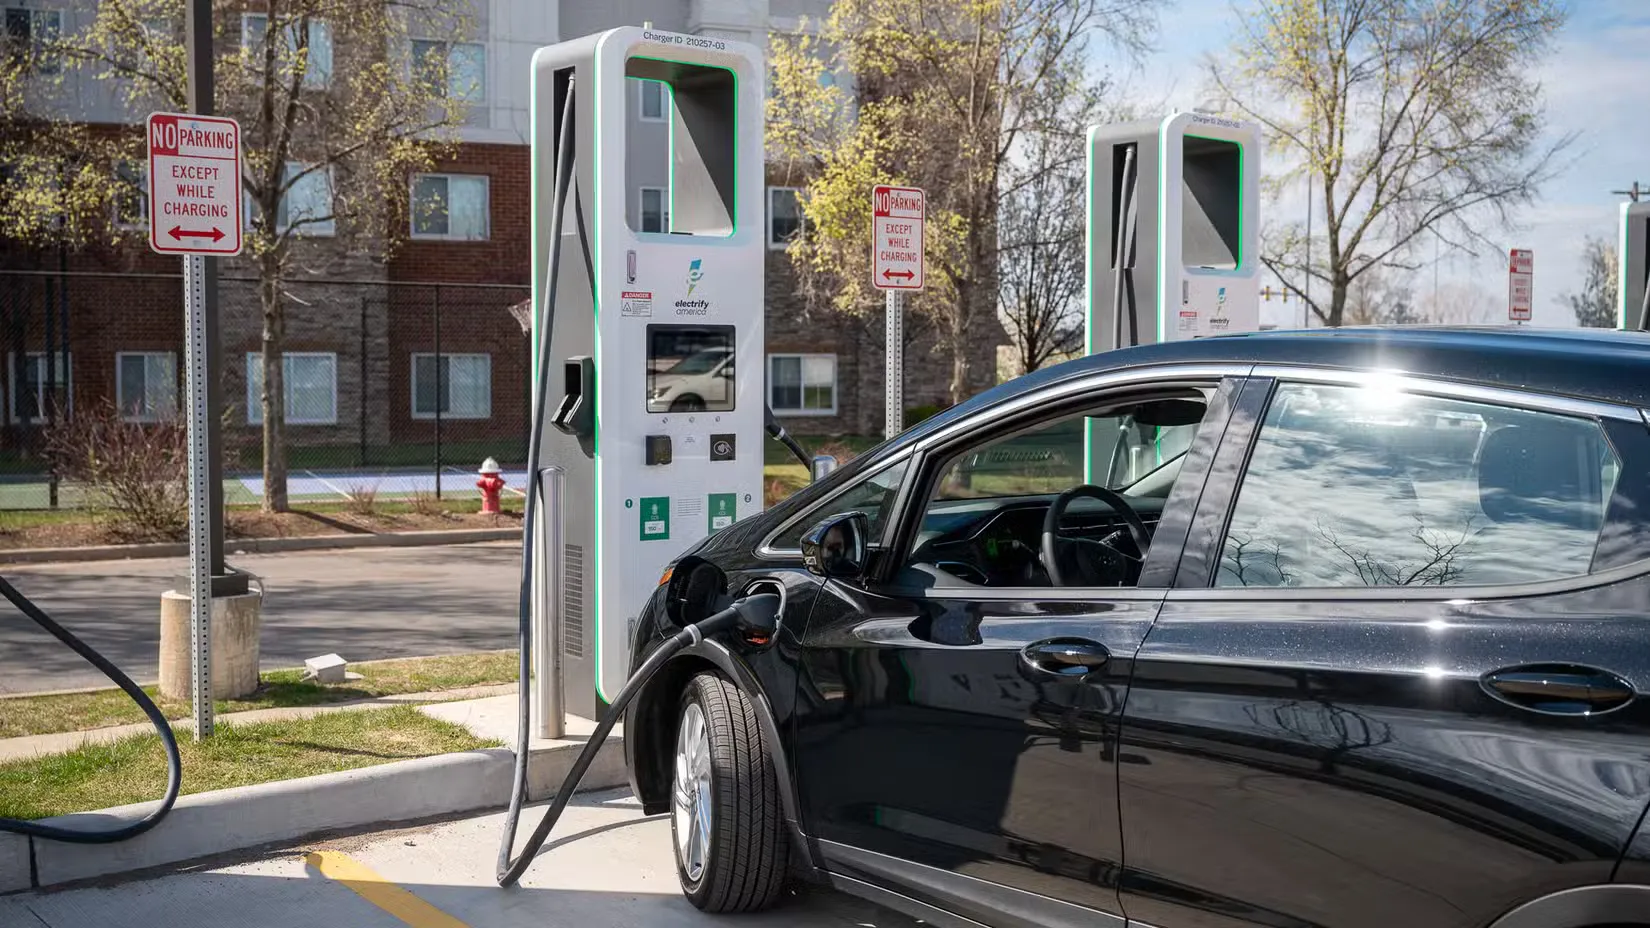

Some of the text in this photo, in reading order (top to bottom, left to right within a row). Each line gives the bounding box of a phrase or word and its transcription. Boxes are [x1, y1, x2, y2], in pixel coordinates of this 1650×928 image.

[643, 32, 725, 50] Charger ID 210257-03
[152, 123, 233, 150] NO PARKING
[172, 165, 219, 180] EXCEPT
[177, 184, 215, 199] WHILE
[164, 202, 228, 218] CHARGING
[876, 193, 921, 213] NO PARKING
[886, 223, 912, 234] EXCEPT
[888, 238, 910, 248] WHILE
[881, 251, 917, 263] CHARGING
[675, 300, 709, 309] electrify
[676, 308, 707, 316] america
